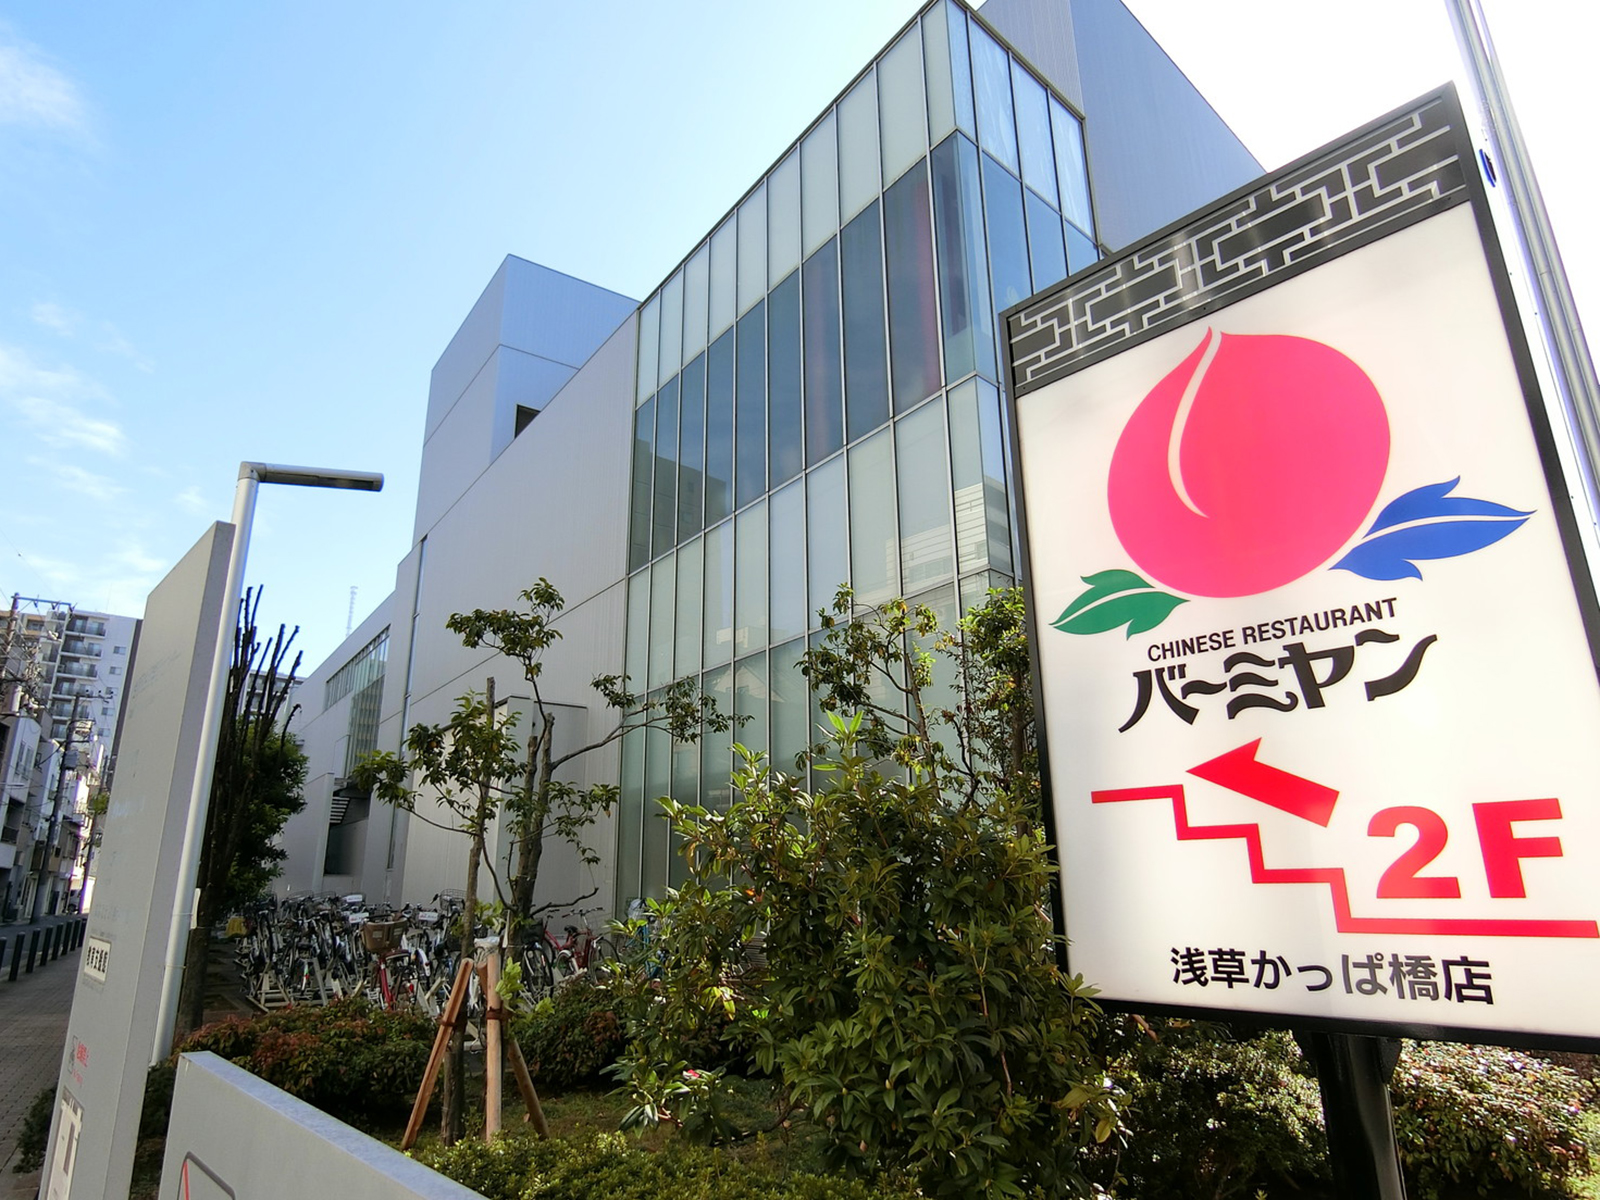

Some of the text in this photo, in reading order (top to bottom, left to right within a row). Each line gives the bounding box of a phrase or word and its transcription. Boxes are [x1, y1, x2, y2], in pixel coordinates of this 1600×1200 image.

[1147, 597, 1398, 662] CHINESE RESTAURANT
[1117, 627, 1439, 734] バーミヤン
[1366, 797, 1564, 899] 2F
[1170, 946, 1494, 1006] 浅草かっぱ橋店
